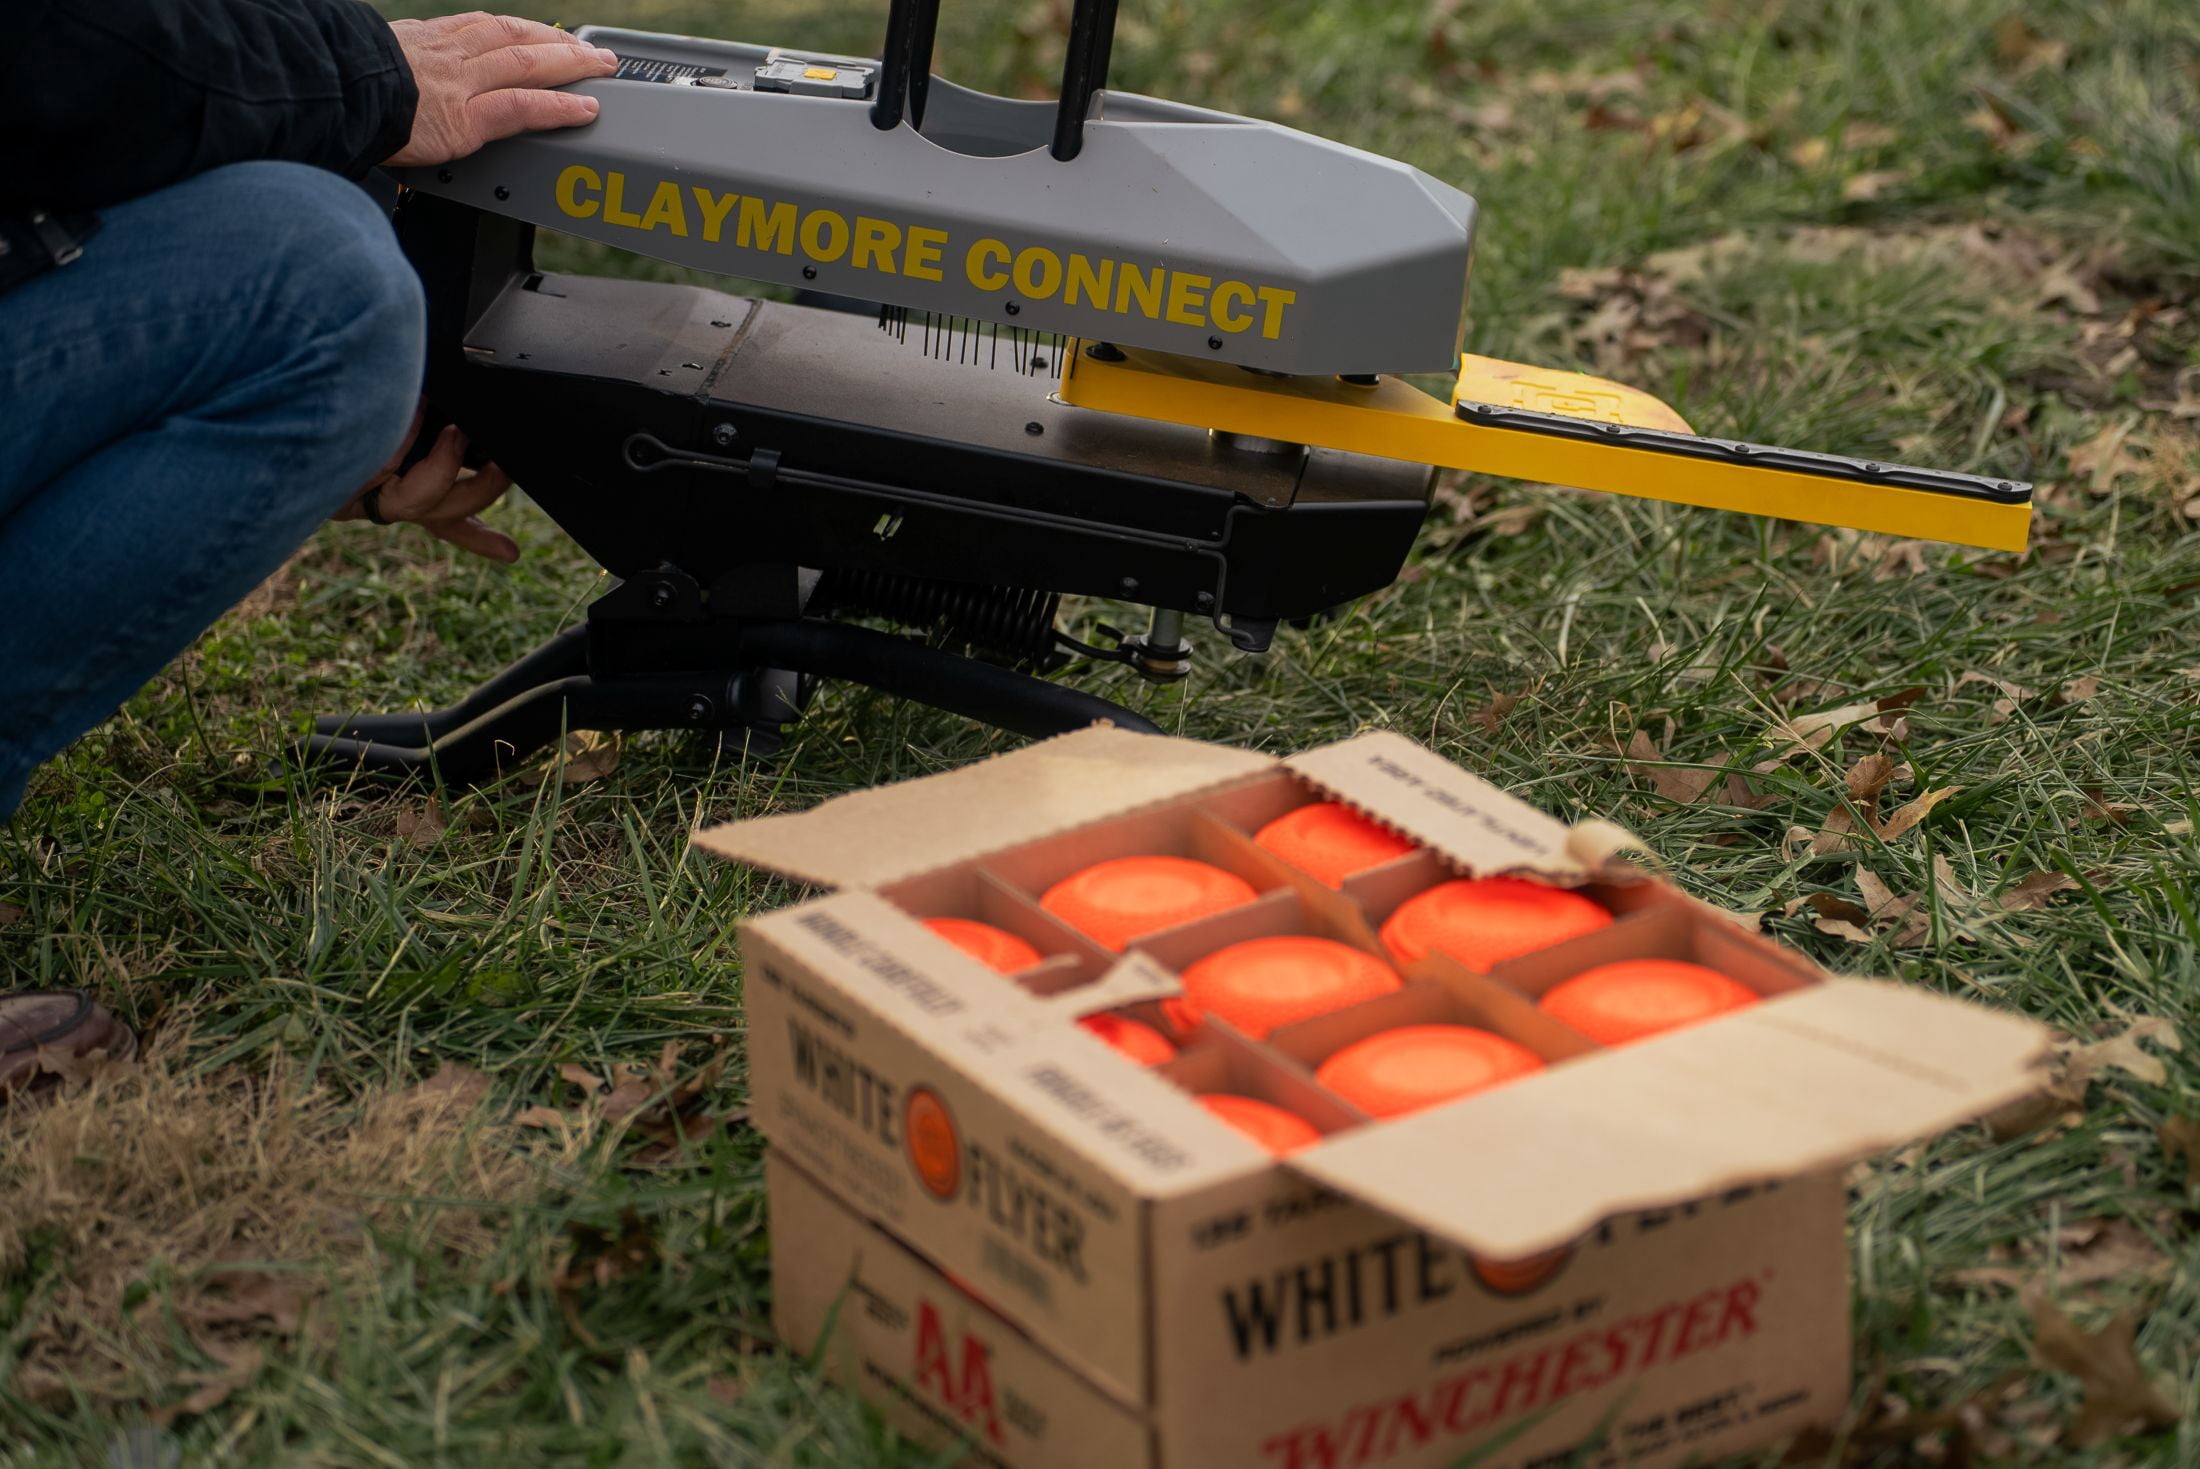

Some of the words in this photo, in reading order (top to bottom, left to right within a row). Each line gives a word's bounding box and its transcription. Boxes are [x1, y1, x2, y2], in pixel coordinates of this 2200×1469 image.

[555, 165, 949, 282] CLAYMORE
[965, 237, 1297, 341] CONNECT
[788, 1016, 898, 1149] WHITE
[965, 1142, 1092, 1287] FLYER
[916, 1297, 1006, 1447] AA
[1221, 1230, 1457, 1361] WHITE
[1261, 1281, 1762, 1468] WINCHESTER
